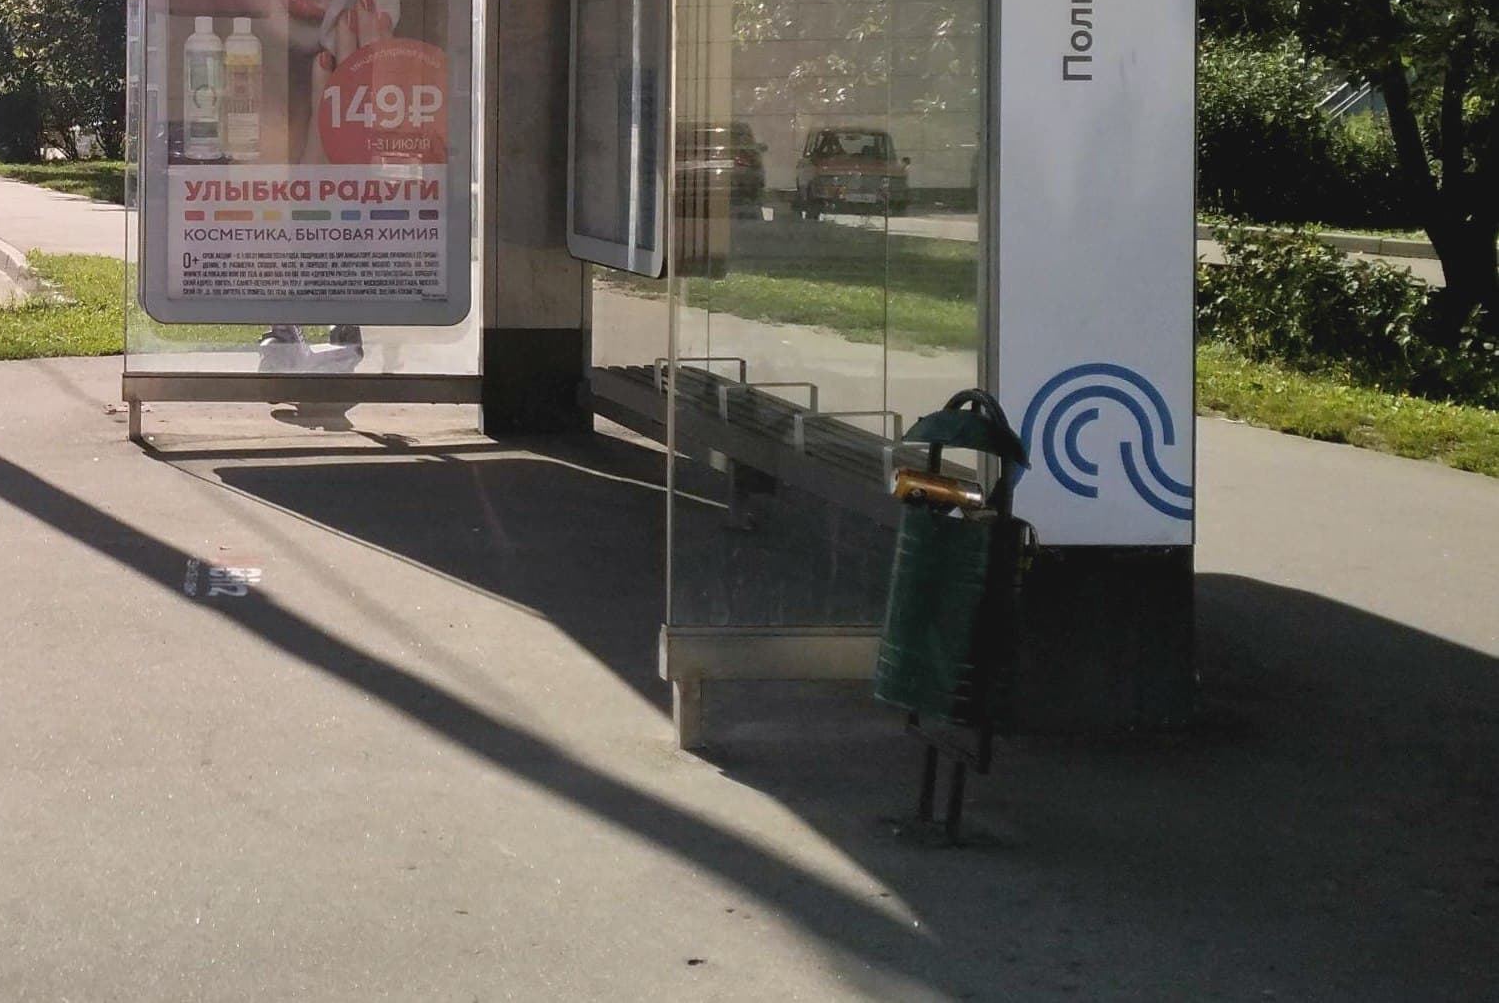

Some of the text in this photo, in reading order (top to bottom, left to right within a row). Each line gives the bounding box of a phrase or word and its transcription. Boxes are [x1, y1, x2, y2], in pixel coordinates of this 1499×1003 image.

[184, 227, 439, 243] КОСМЕТИКА, БЫТОВАЯ ХИМИЯ
[183, 252, 200, 269] 0+
